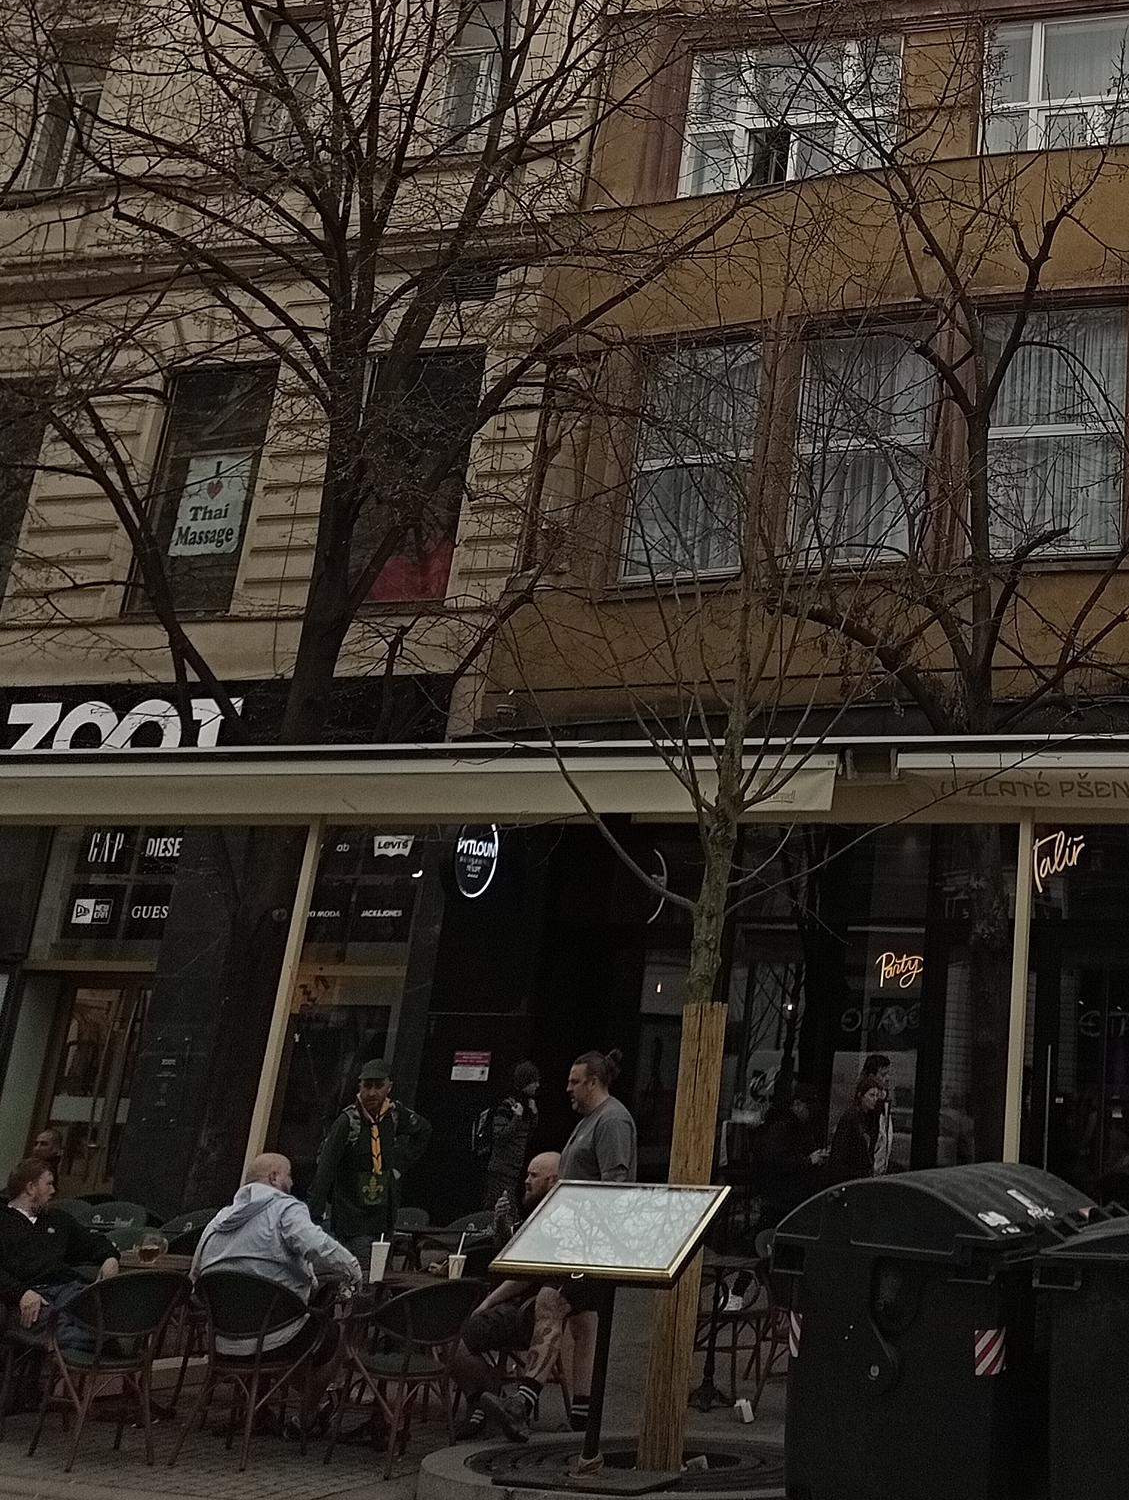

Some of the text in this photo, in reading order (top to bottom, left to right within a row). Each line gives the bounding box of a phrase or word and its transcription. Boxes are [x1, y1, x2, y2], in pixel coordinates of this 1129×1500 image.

[214, 460, 223, 477] I
[189, 503, 230, 522] Thai
[174, 525, 234, 548] Massage
[966, 770, 1051, 798] ZLATÉ
[87, 832, 125, 863] GAP
[457, 836, 496, 859] PYTLOUN
[875, 952, 925, 989] Party
